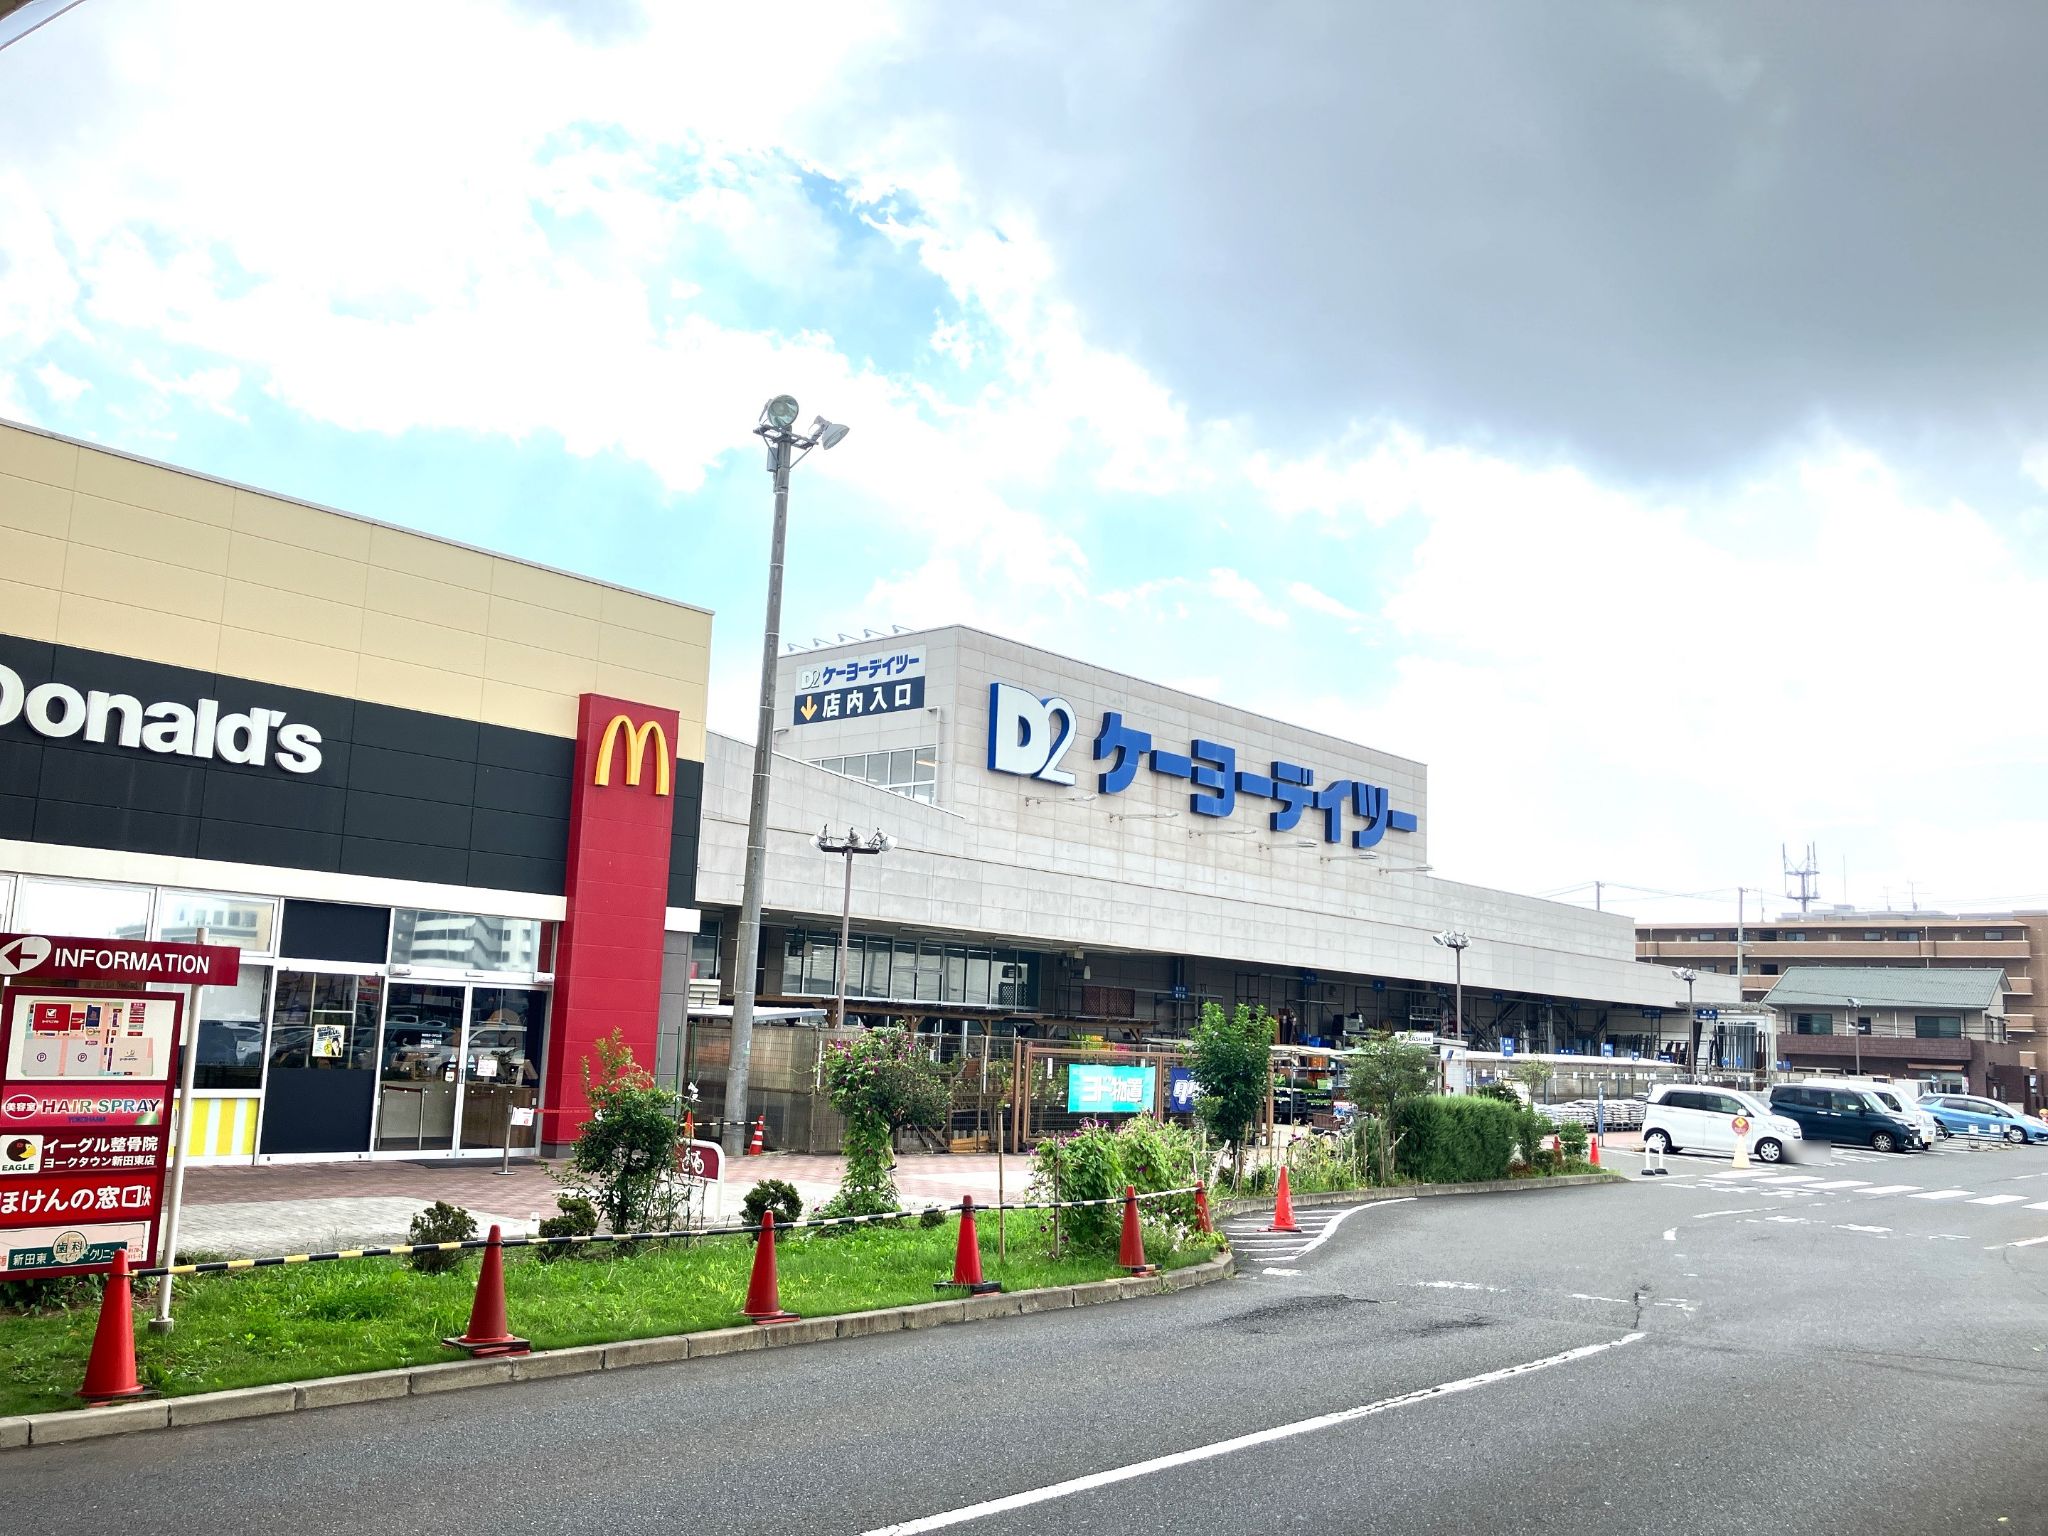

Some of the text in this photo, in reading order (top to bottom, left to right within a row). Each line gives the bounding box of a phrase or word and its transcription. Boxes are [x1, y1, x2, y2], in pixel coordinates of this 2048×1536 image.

[822, 653, 920, 686] ケーヨーデイツー
[822, 683, 912, 719] 店内入口
[987, 682, 1418, 850] D2 ケーヨーデイツー
[54, 948, 209, 974] INFORMATION
[5, 1101, 38, 1113] 美容室
[41, 1099, 160, 1114] HAIR SPRAY
[43, 1136, 158, 1154] イーグル整骨院
[2, 1163, 35, 1172] EAGLE
[43, 1154, 156, 1169] ヨークタウン新田東店
[0, 1185, 142, 1215] ほけんの窓口
[12, 1252, 47, 1267] 新田東
[56, 1240, 83, 1254] 歯科
